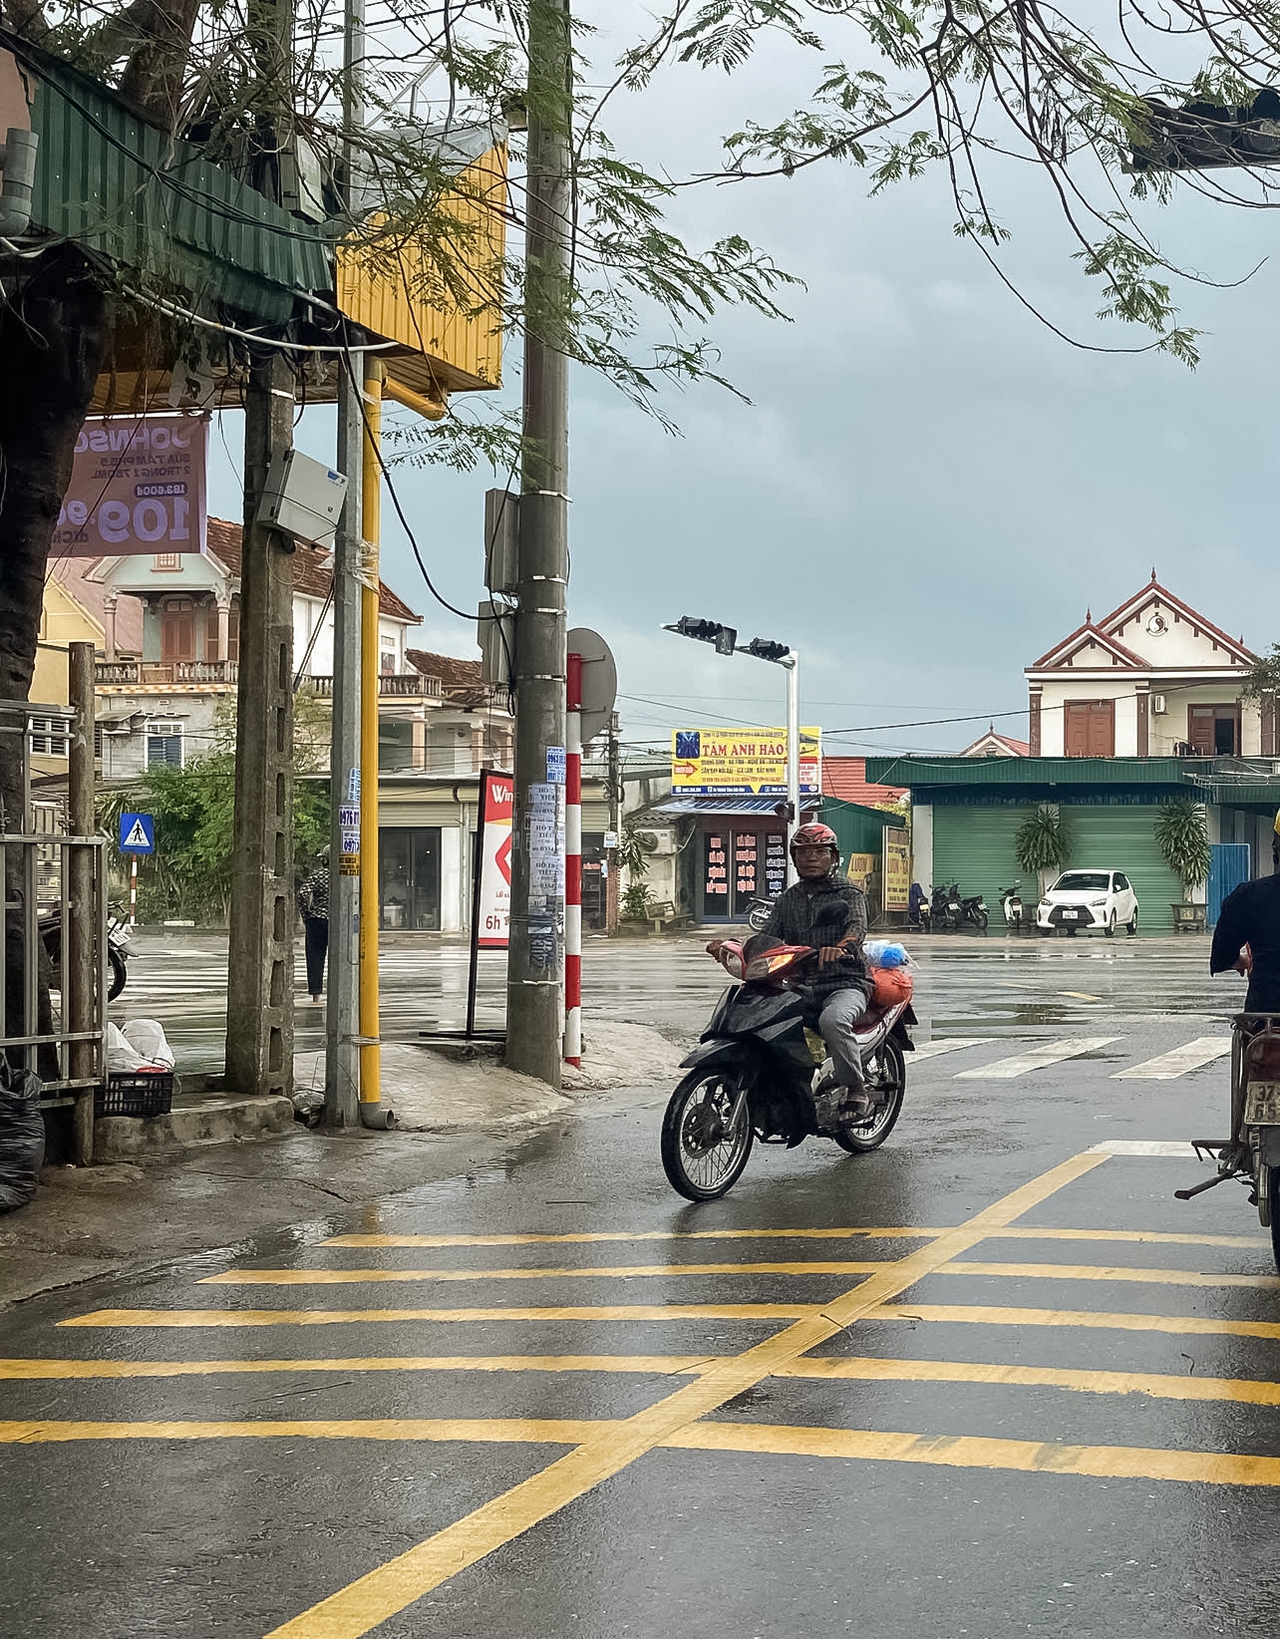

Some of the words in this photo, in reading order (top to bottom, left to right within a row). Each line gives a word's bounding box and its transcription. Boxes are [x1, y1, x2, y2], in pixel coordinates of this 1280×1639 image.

[703, 741, 727, 756] TÂM
[731, 744, 755, 756] ANH
[486, 915, 500, 930] 6h
